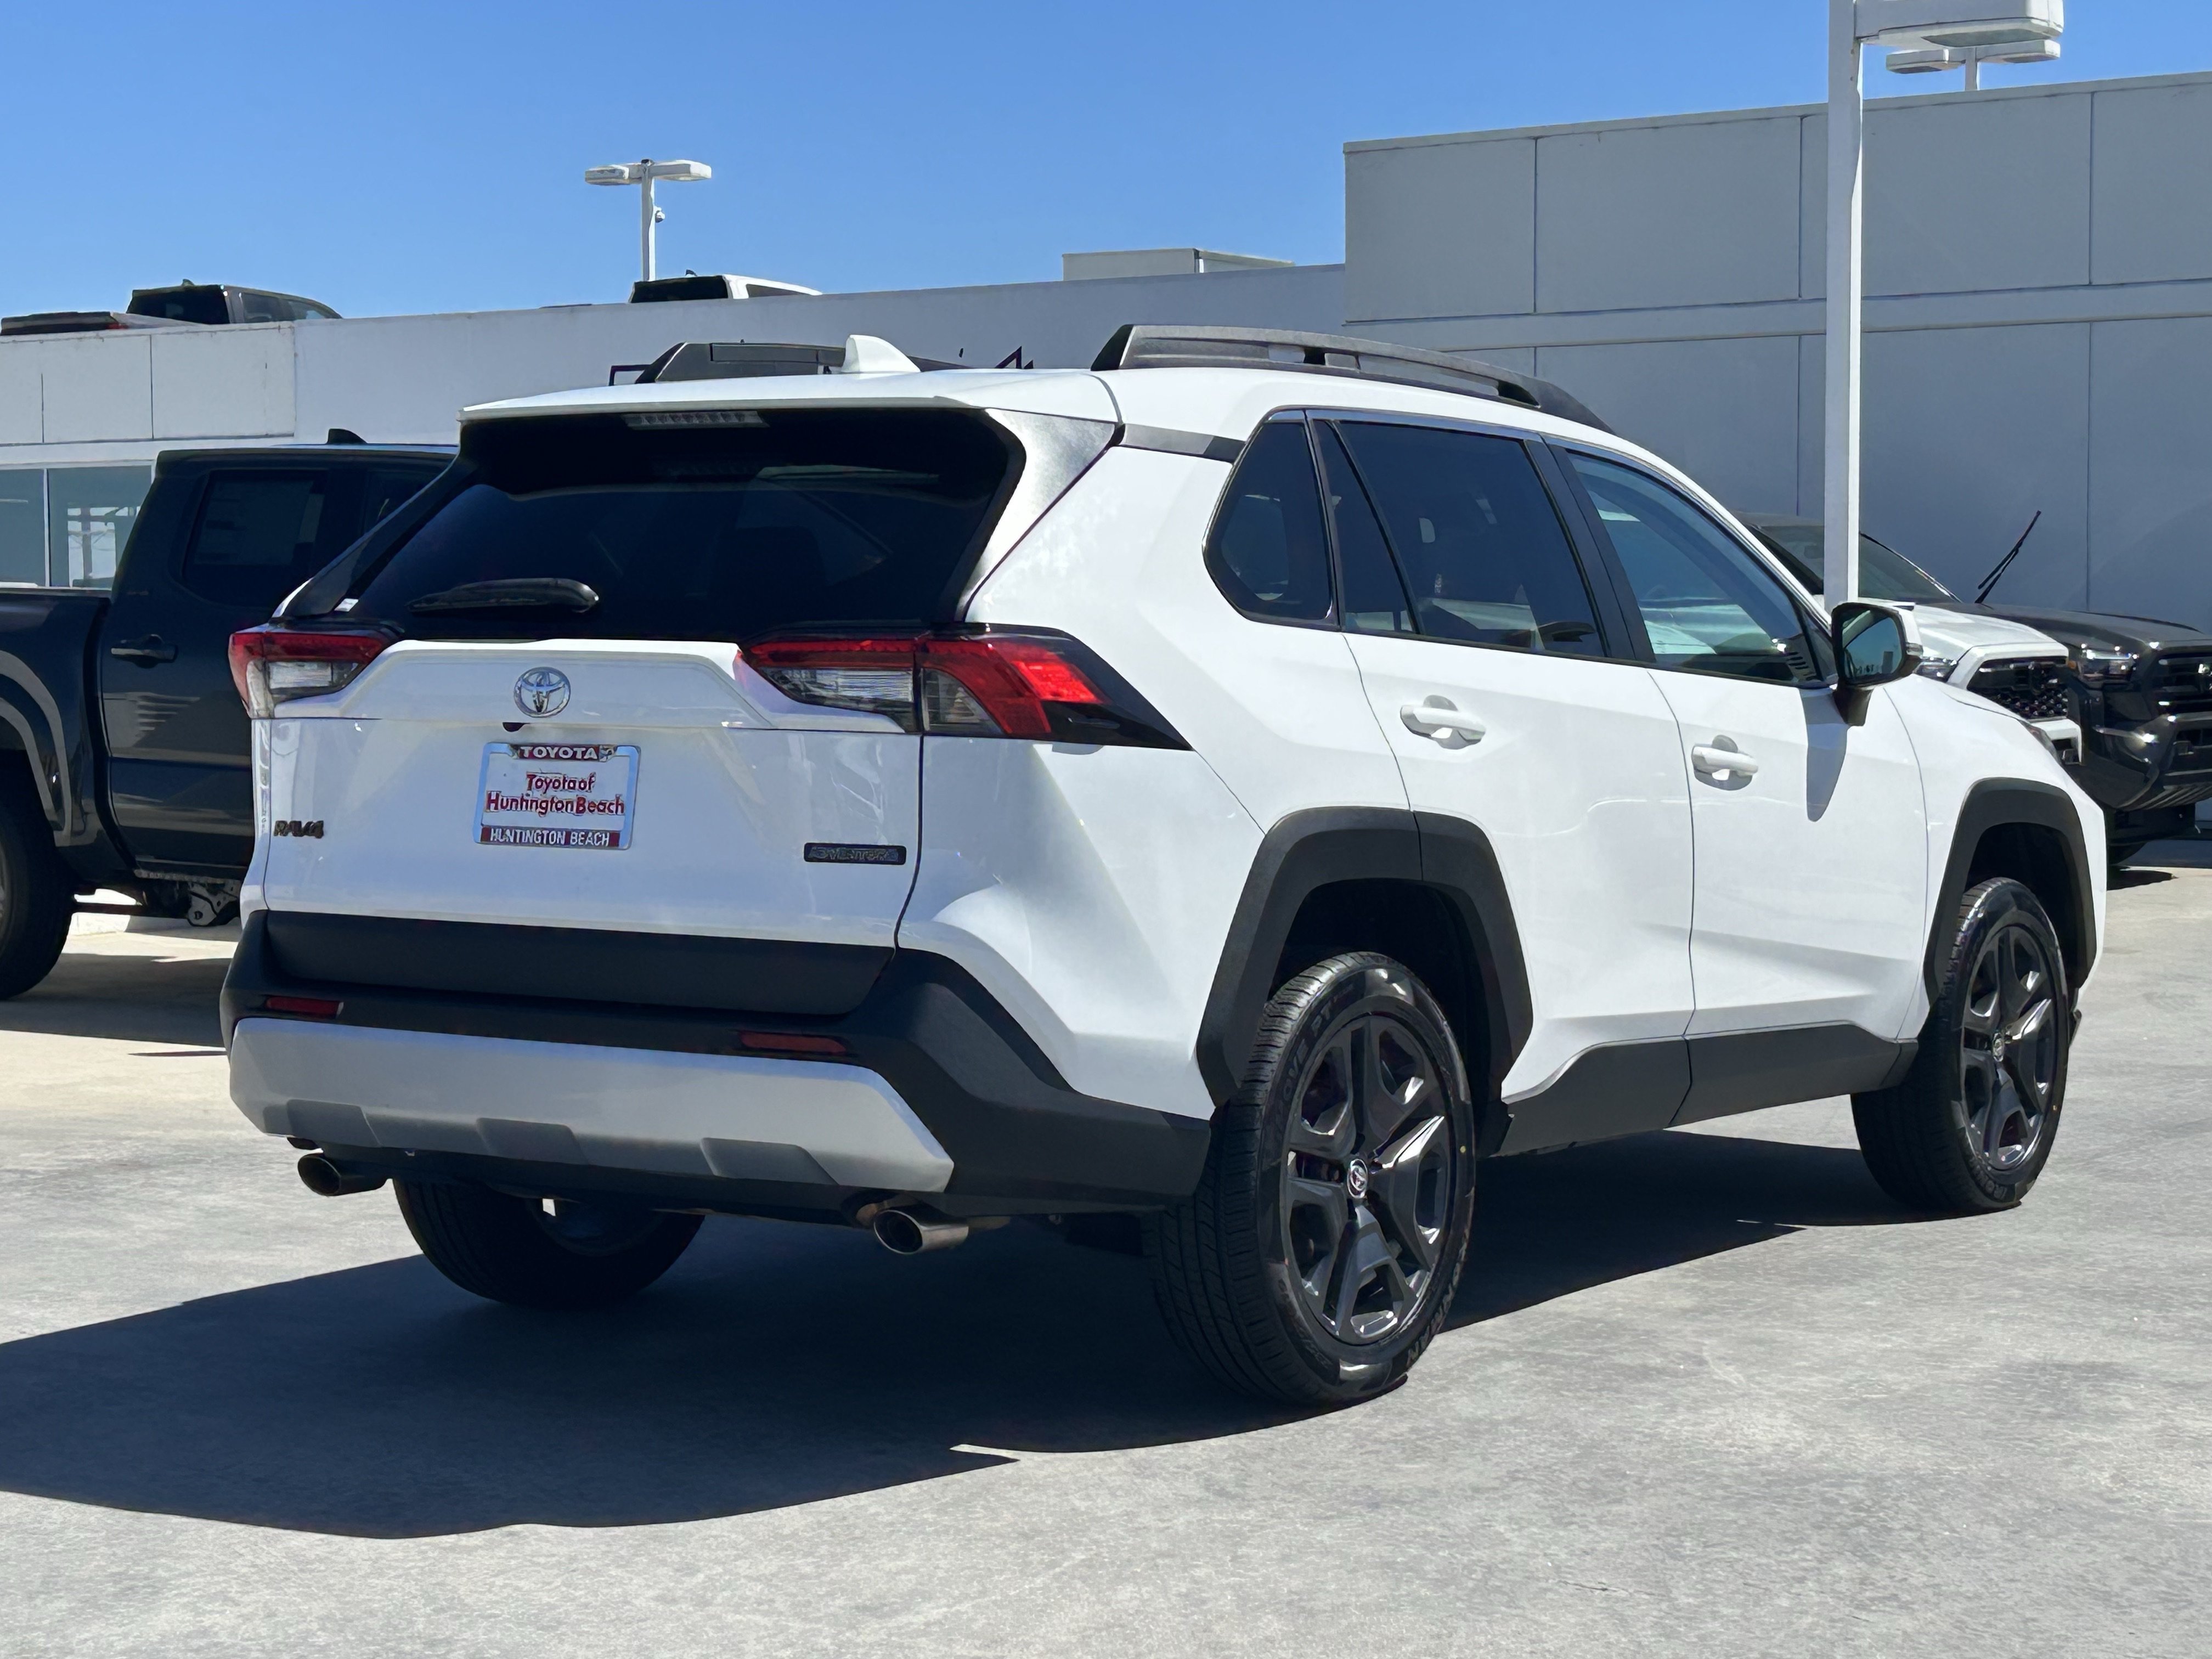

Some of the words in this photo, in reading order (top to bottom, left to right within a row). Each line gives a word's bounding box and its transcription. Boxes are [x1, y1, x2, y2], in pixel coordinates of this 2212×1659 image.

[520, 746, 598, 759] TOYOTA
[526, 774, 576, 794] Toyota
[578, 772, 596, 791] of
[486, 791, 574, 817] Huntington
[575, 794, 625, 815] Beach
[490, 828, 566, 845] HUNTINGTON
[569, 832, 610, 847] BEACH
